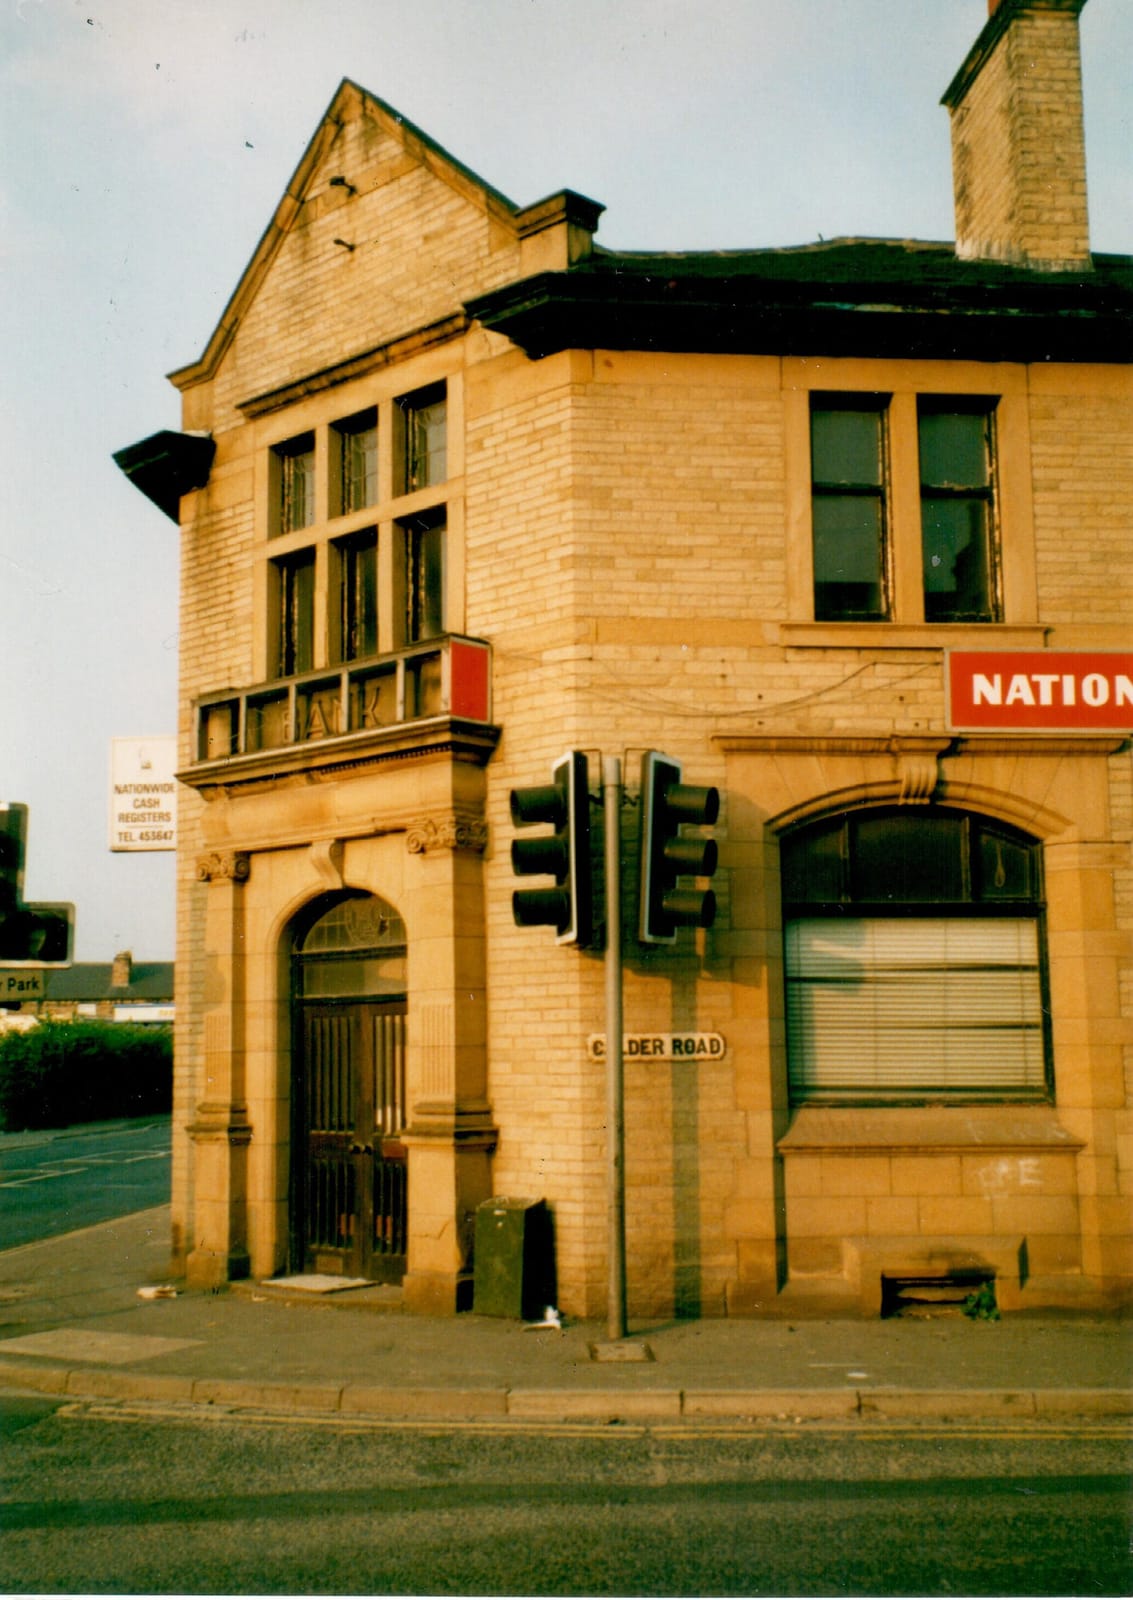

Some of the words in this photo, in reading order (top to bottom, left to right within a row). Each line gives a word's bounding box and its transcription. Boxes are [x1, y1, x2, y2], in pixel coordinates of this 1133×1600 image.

[114, 783, 175, 794] NATIONWIDE
[133, 798, 160, 809] CASH
[118, 812, 172, 823] REGISTERS
[8, 977, 40, 991] Park
[592, 1038, 665, 1056] CDER
[672, 1038, 721, 1055] ROAD
